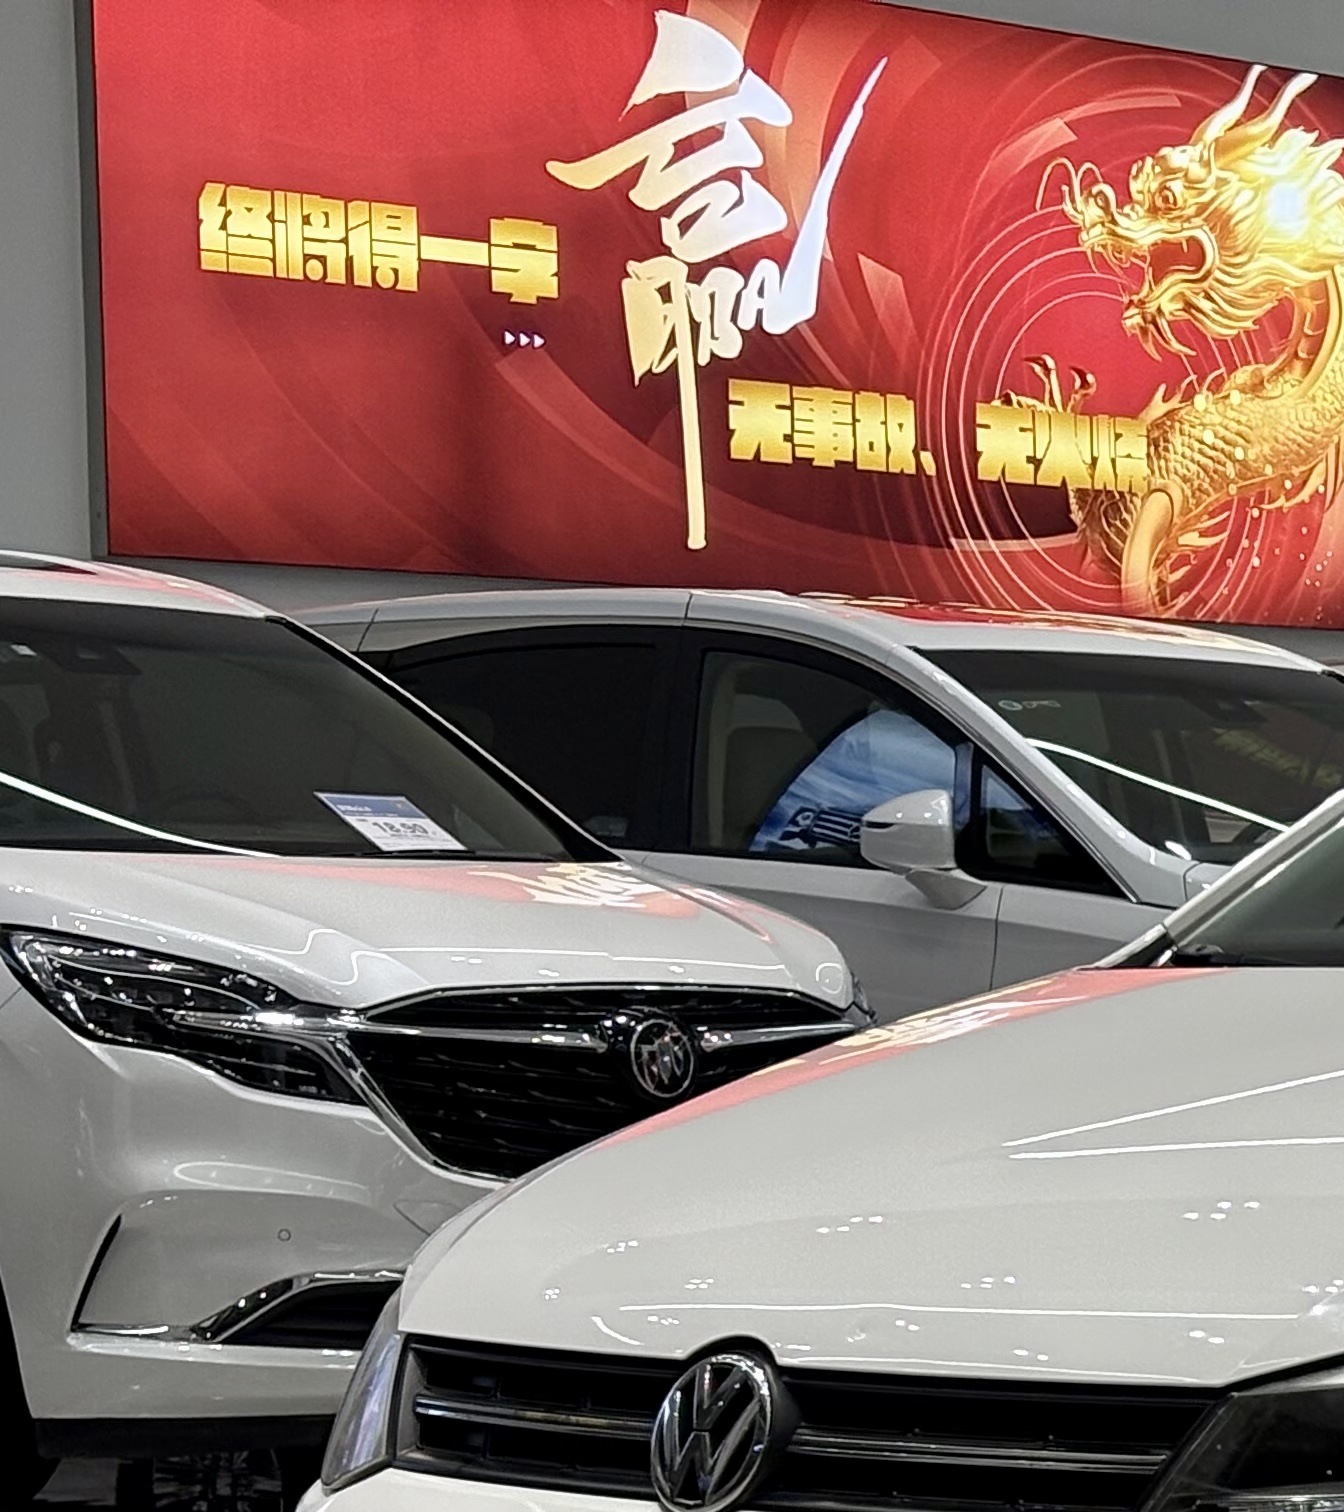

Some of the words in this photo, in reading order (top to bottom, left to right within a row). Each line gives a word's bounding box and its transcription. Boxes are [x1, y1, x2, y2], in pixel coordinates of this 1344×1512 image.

[199, 182, 559, 304] 终将得一字
